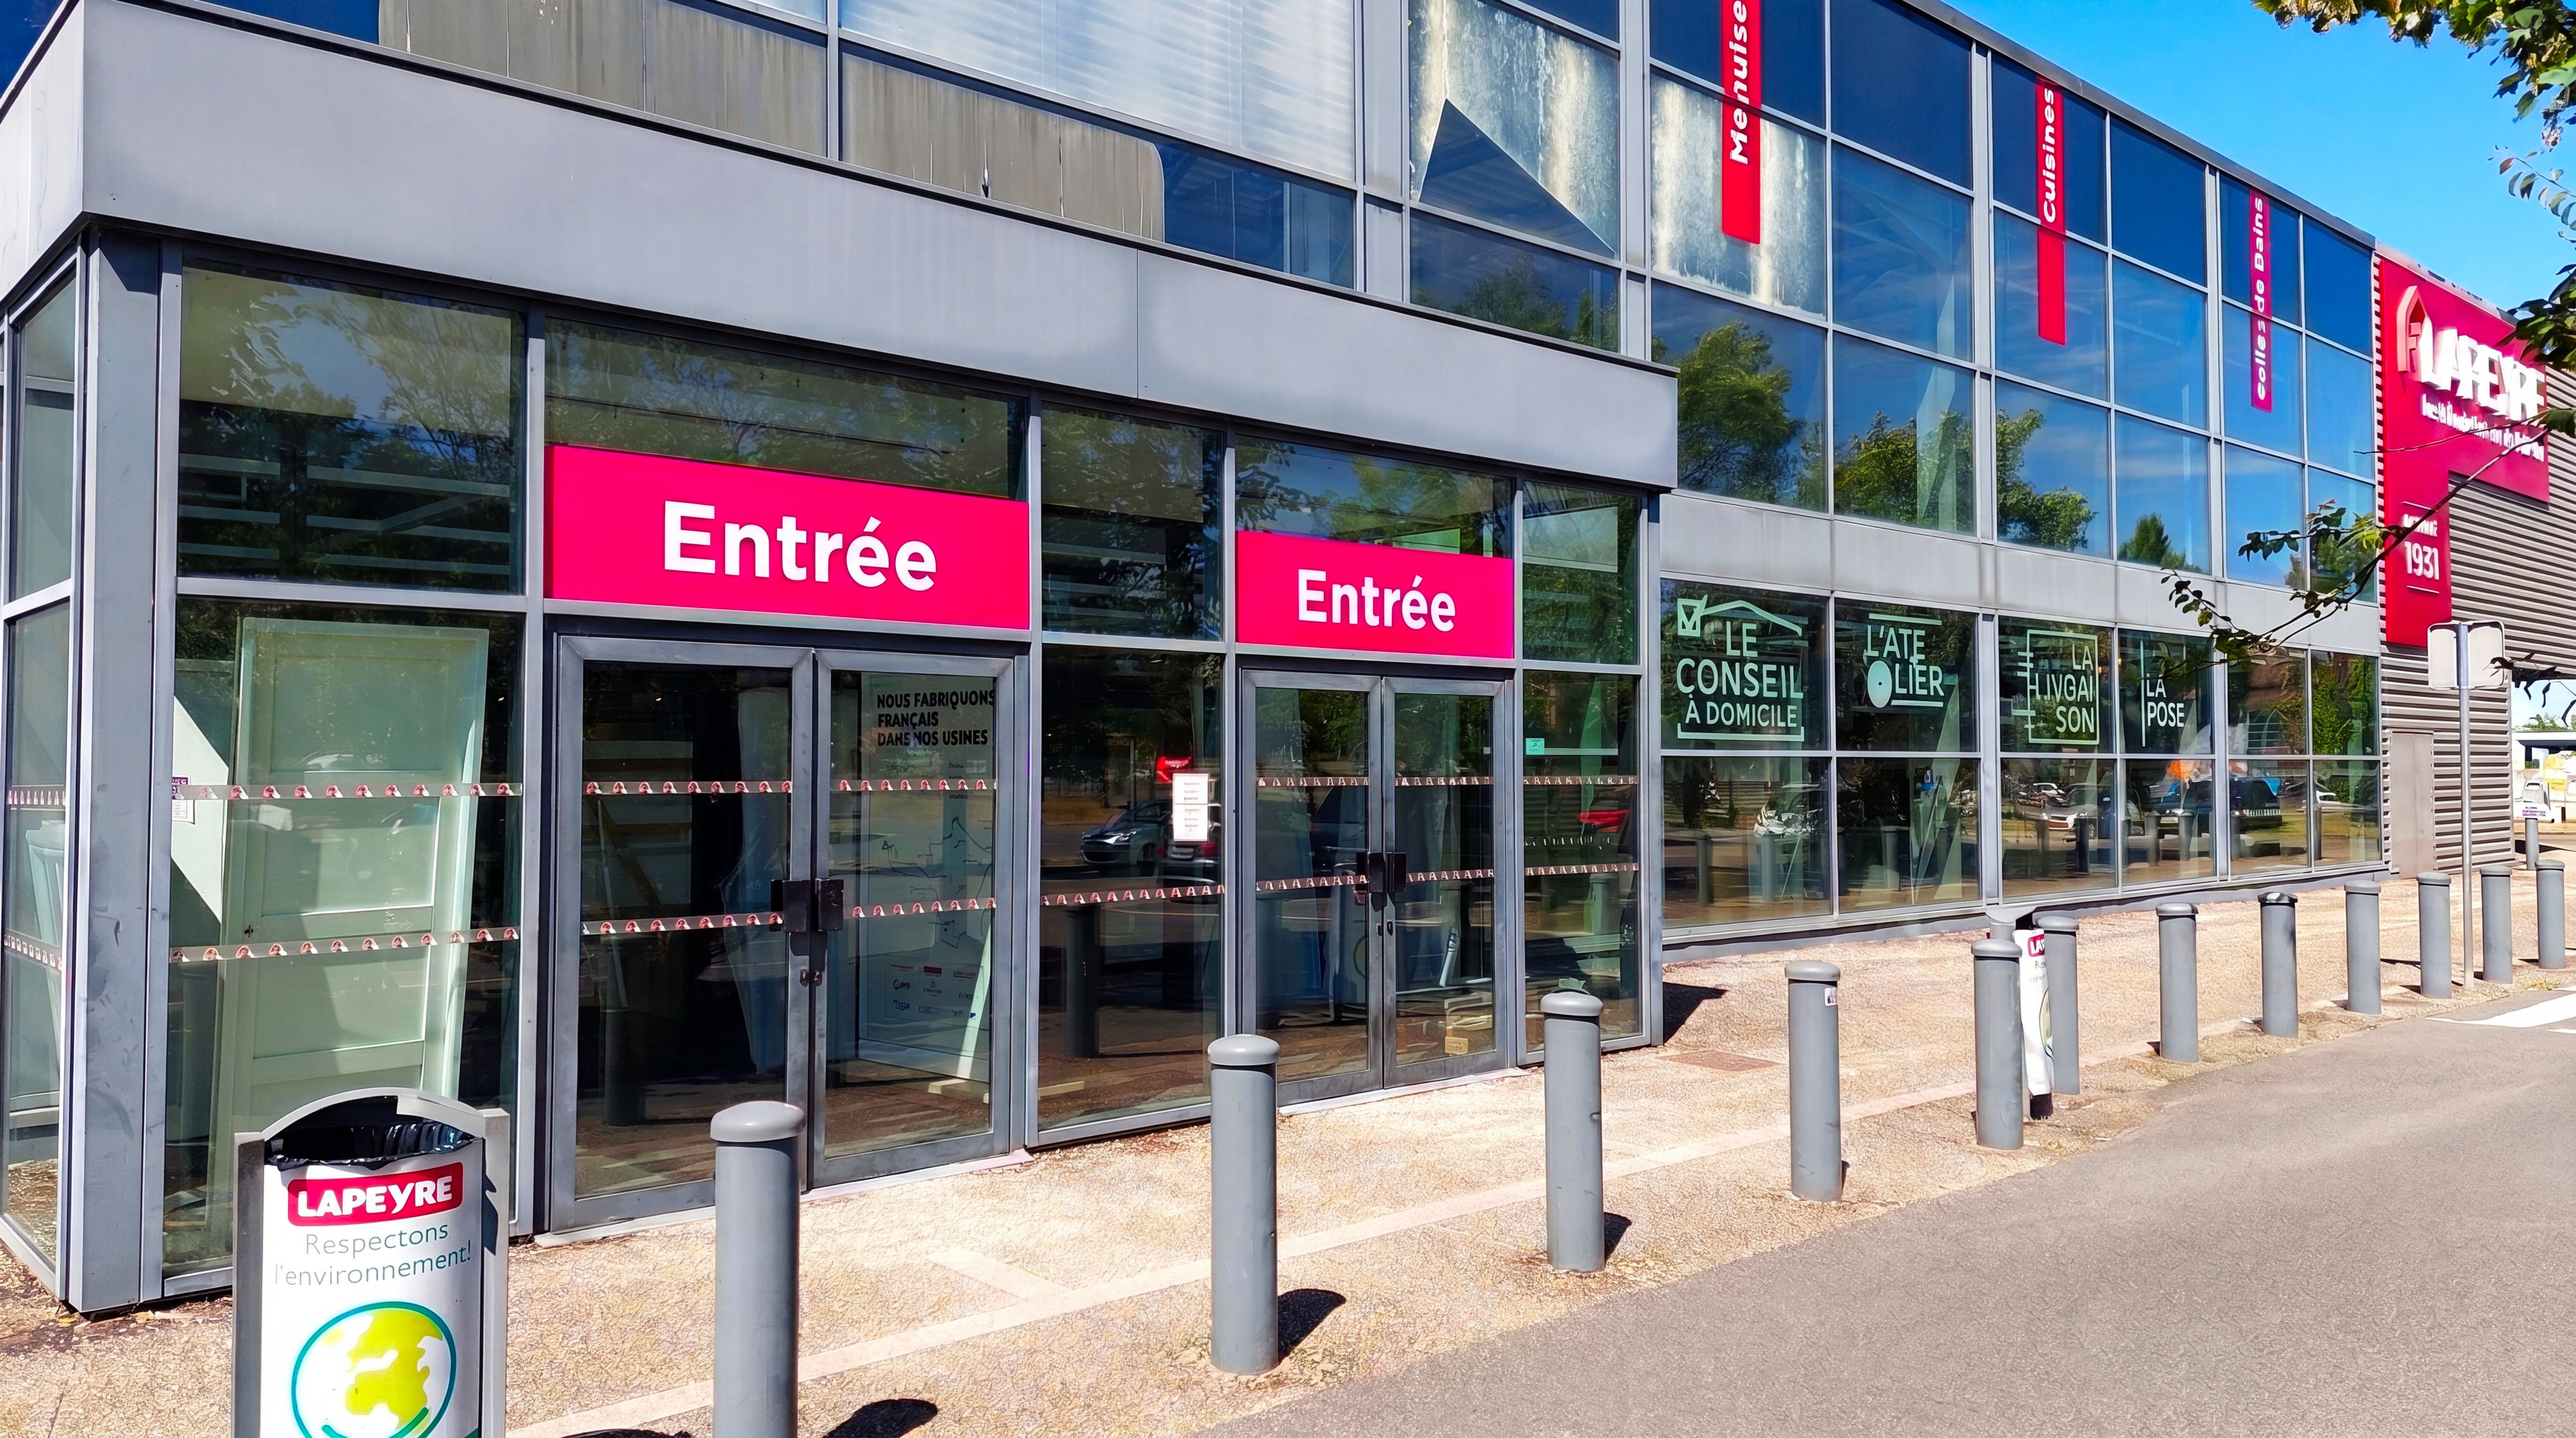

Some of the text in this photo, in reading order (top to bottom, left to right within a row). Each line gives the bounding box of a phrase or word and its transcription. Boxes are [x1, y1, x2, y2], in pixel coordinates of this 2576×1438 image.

[2042, 88, 2056, 223] Cuisines
[2253, 198, 2264, 272] Bains
[2254, 279, 2265, 313] de
[664, 500, 937, 591] Entrée
[2404, 541, 2440, 580] 1931
[1298, 568, 1456, 632] Entrée
[1726, 621, 1758, 657] LE
[2072, 644, 2093, 670] LA
[1677, 658, 1804, 699] CONSEIL
[2146, 673, 2166, 698] LA
[877, 690, 995, 710] NOUS FABRIQUONS
[1685, 693, 1798, 728] À DOMICILE
[2147, 701, 2185, 727] POSE
[878, 711, 939, 729] FRANÇAIS
[2056, 705, 2094, 733] SON
[877, 729, 988, 747] DANS NOS USINES
[297, 1175, 453, 1218] LAPEYRE
[305, 1223, 449, 1259] Respectons
[274, 1240, 472, 1286] l'environnement!
